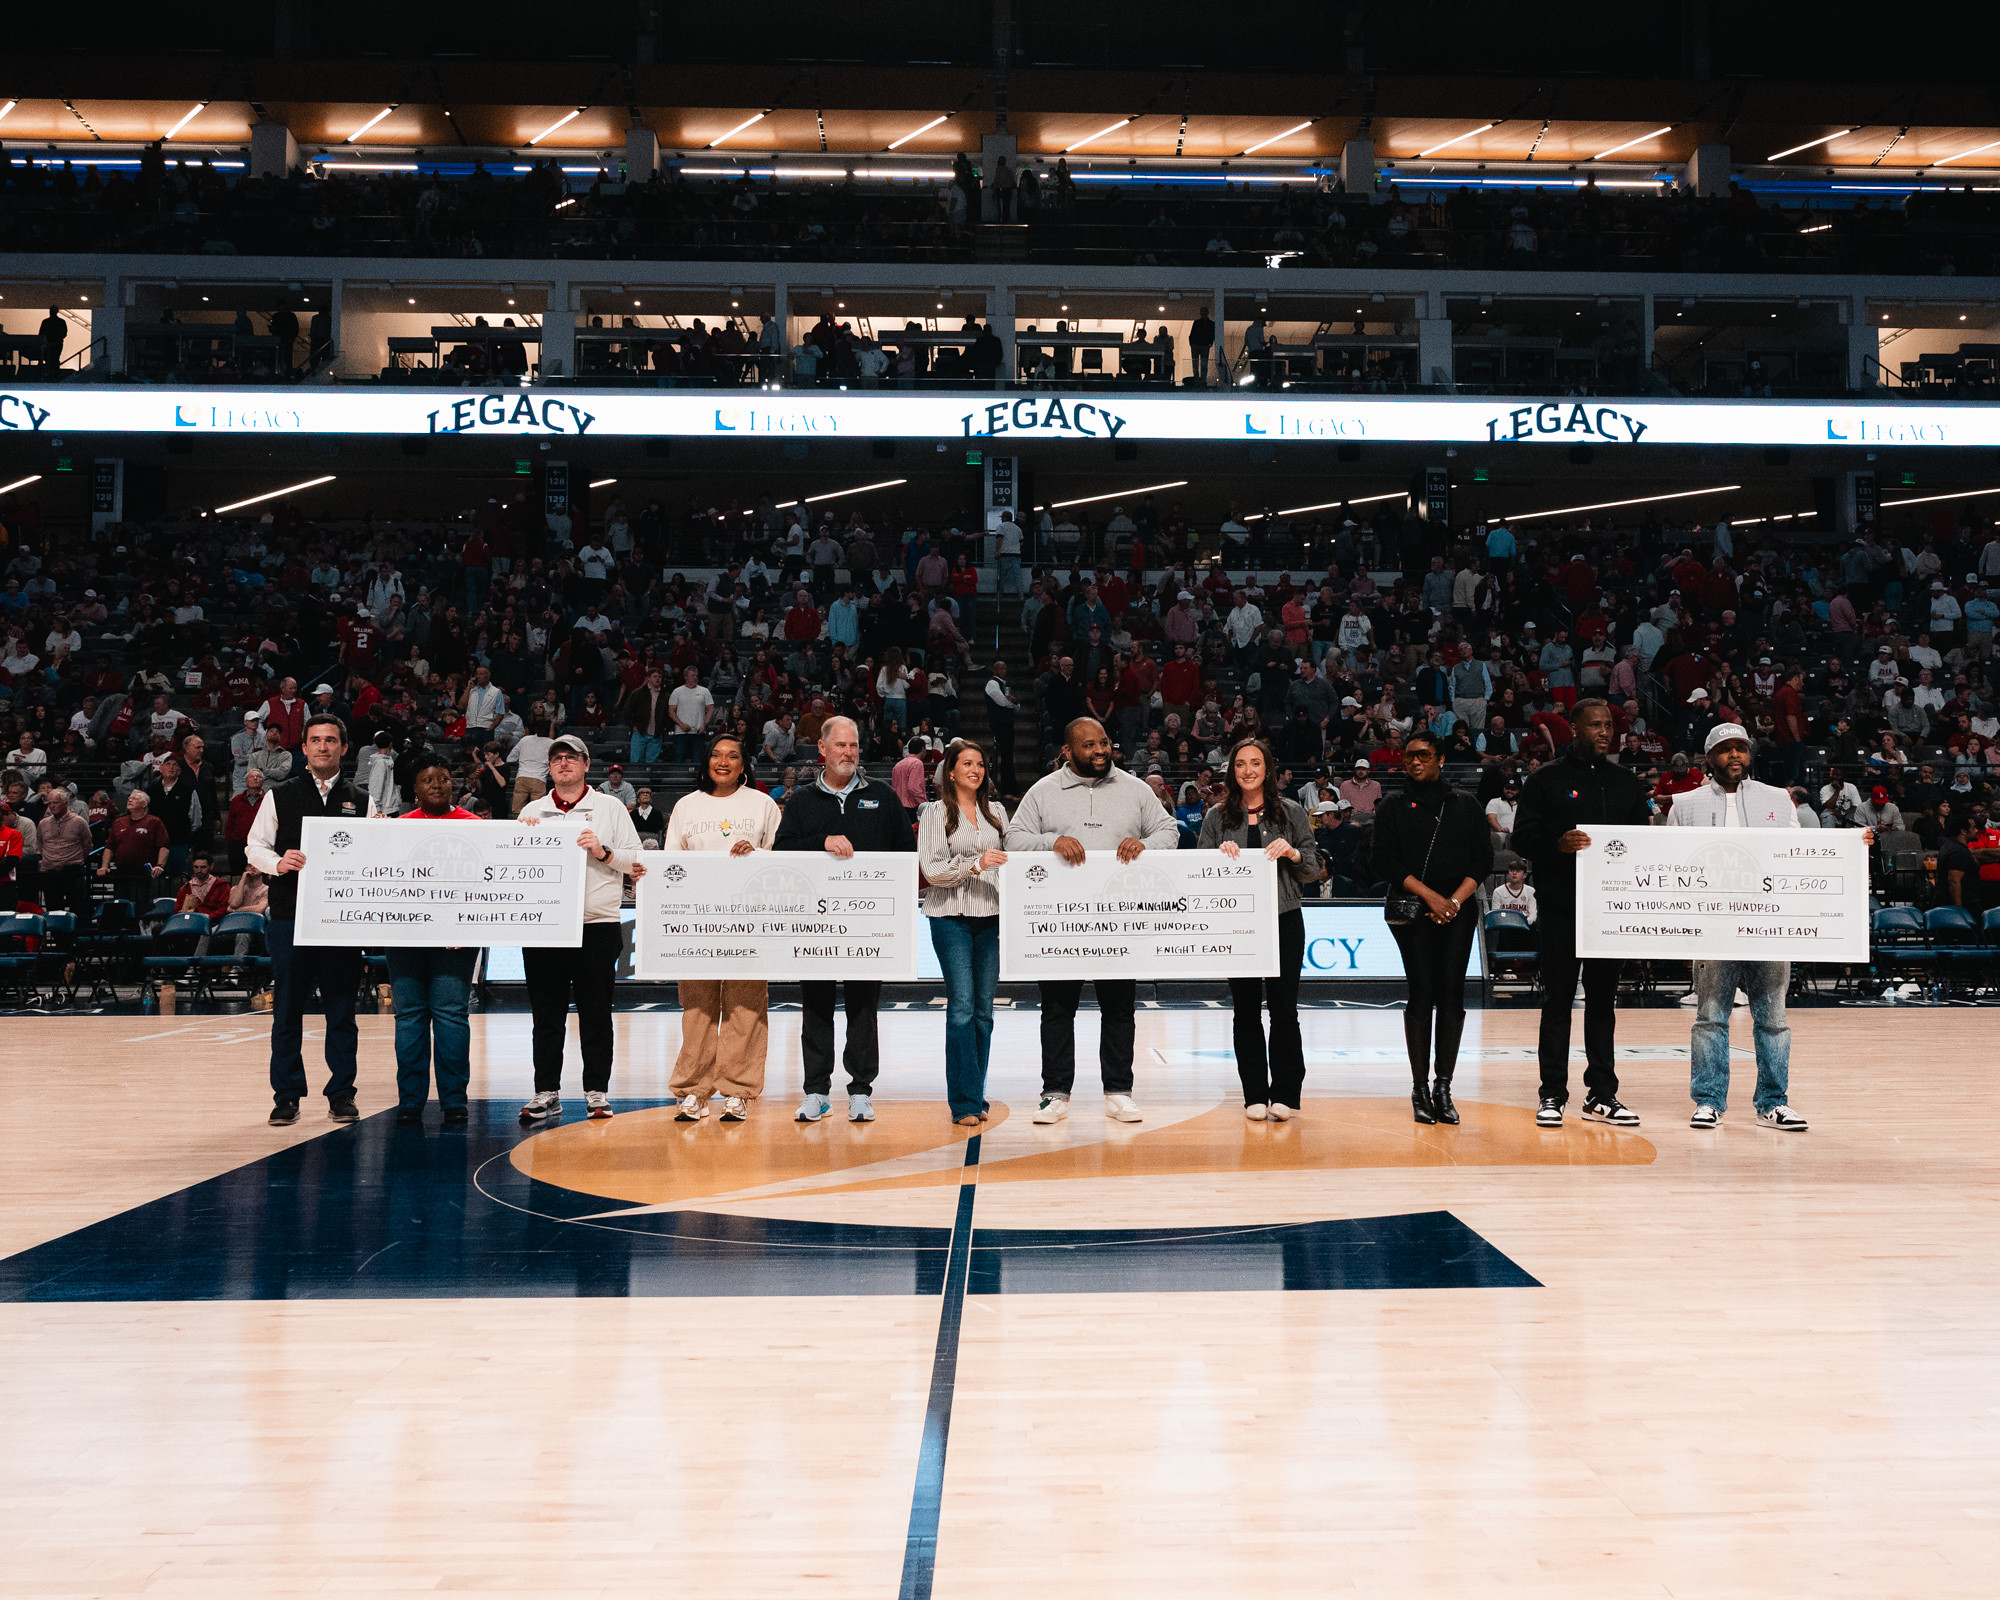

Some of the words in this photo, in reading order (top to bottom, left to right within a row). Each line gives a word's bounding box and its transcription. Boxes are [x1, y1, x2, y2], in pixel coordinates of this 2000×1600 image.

[211, 406, 304, 428] LEGACY
[427, 394, 595, 435] LEGACY
[961, 398, 1126, 438] LEGACY
[750, 411, 842, 431] LEGACY
[1280, 415, 1369, 435] LEGACY
[1486, 403, 1648, 443] LEGACY
[1860, 421, 1949, 441] LEGACY
[96, 475, 112, 484] 127
[994, 469, 1011, 478] 129
[549, 477, 565, 486] 128
[1429, 483, 1445, 492] 130
[96, 493, 112, 501] 128
[993, 487, 1011, 496] 130
[548, 495, 565, 504] 129
[1430, 501, 1445, 510] 131
[1857, 504, 1873, 513] 132
[1475, 525, 1486, 536] 18
[357, 633, 368, 649] 2
[513, 836, 562, 847] 12.13.25
[1790, 848, 1836, 857] 12.13.25
[362, 867, 405, 878] GIRLS
[483, 866, 493, 882] $
[499, 867, 545, 880] 2,500
[843, 870, 887, 879] 12.13.25
[1201, 866, 1252, 878] 12.13.25
[1634, 864, 1705, 874] EVERYBODY
[1762, 877, 1773, 893] $
[1779, 878, 1828, 891] 2,500
[327, 887, 354, 898] TWO
[359, 887, 426, 898] THOUSAND
[430, 889, 459, 900] FIVE
[465, 891, 524, 902] HUNDRED
[694, 904, 711, 914] THE
[817, 898, 827, 915] $
[1057, 902, 1090, 913] FIRST
[1096, 902, 1116, 912] TEE
[1178, 896, 1187, 913] $
[1606, 900, 1632, 911] TWO
[1635, 900, 1691, 911] THOUSAND
[1697, 902, 1724, 912] FIVE
[1729, 902, 1780, 913] HUNDRED
[458, 912, 506, 922] KNIGHT
[510, 912, 543, 922] EADY
[663, 923, 689, 934] TWO
[693, 923, 755, 934] THOUSAND
[762, 922, 788, 933] FIVE
[791, 923, 848, 935] HUNDRED
[1029, 922, 1057, 934] TWO
[1060, 921, 1118, 932] THOUSAND
[1123, 921, 1149, 932] FIVE
[1154, 922, 1209, 931] HUNDRED
[1738, 926, 1783, 936] KNIGHT
[1789, 927, 1818, 938] EADY
[793, 946, 840, 957] KNIGHT
[847, 947, 881, 957] EADY
[1156, 945, 1196, 955] KNIGHT
[1202, 944, 1232, 954] EADY
[1301, 938, 1364, 969] CY
